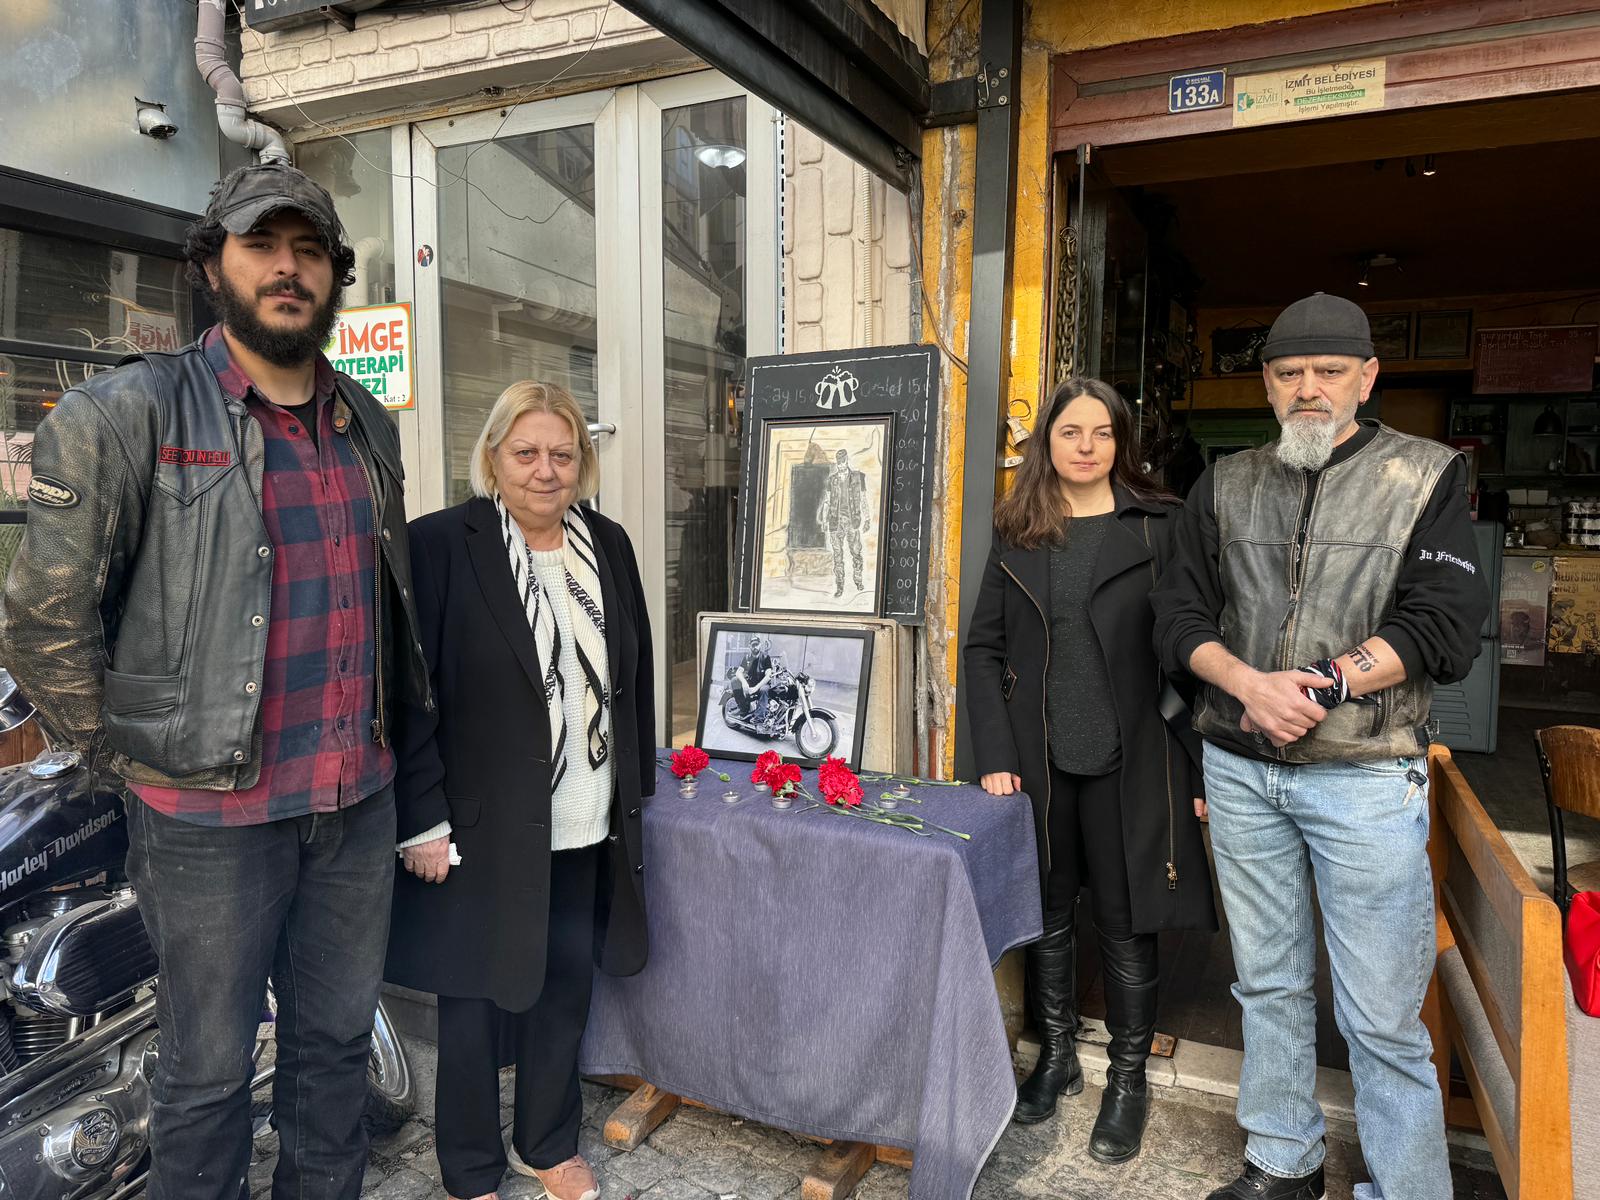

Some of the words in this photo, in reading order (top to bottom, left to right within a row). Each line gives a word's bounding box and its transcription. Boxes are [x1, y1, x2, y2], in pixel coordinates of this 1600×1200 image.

[1314, 68, 1376, 85] BELEDİYESİ
[1172, 84, 1219, 108] 133A
[338, 319, 404, 355] İMGE
[331, 350, 404, 376] OTERAPİ
[359, 373, 387, 395] EZİ
[384, 395, 396, 403] Kat
[162, 448, 178, 461] SEE
[196, 451, 206, 462] IN
[207, 451, 229, 463] HELL
[1418, 549, 1433, 561] In
[1435, 551, 1476, 576] Friendship
[0, 809, 122, 894] Harley-Davidson
